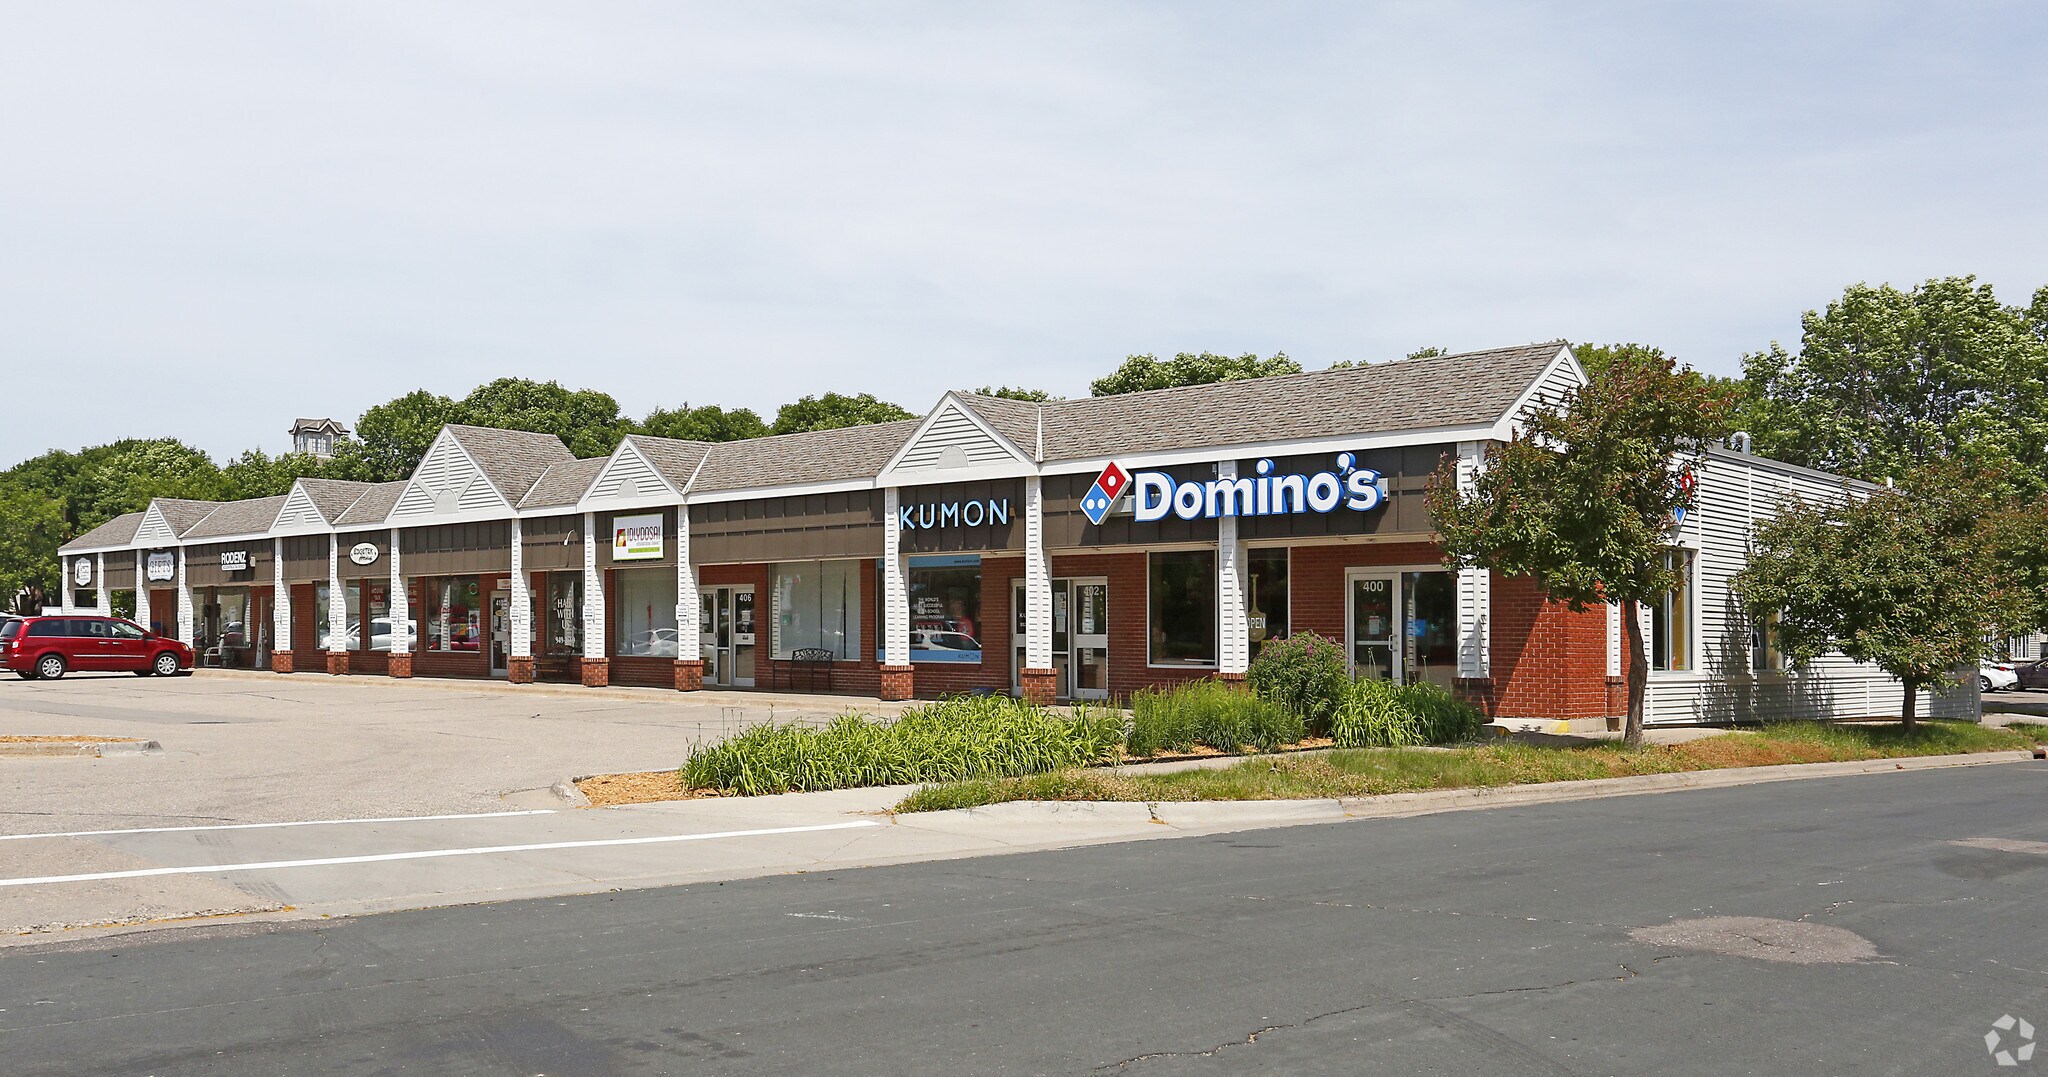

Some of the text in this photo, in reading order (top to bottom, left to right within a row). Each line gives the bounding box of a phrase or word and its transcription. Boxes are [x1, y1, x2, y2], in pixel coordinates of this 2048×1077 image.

[1133, 452, 1381, 522] Domino's
[900, 498, 1008, 530] KUMON
[221, 551, 247, 564] RODENZ
[149, 560, 171, 574] GIFTS
[1083, 586, 1099, 596] 402
[1363, 581, 1383, 592] 400
[557, 598, 573, 608] HAIR
[739, 593, 752, 602] 406
[556, 608, 575, 619] WITH
